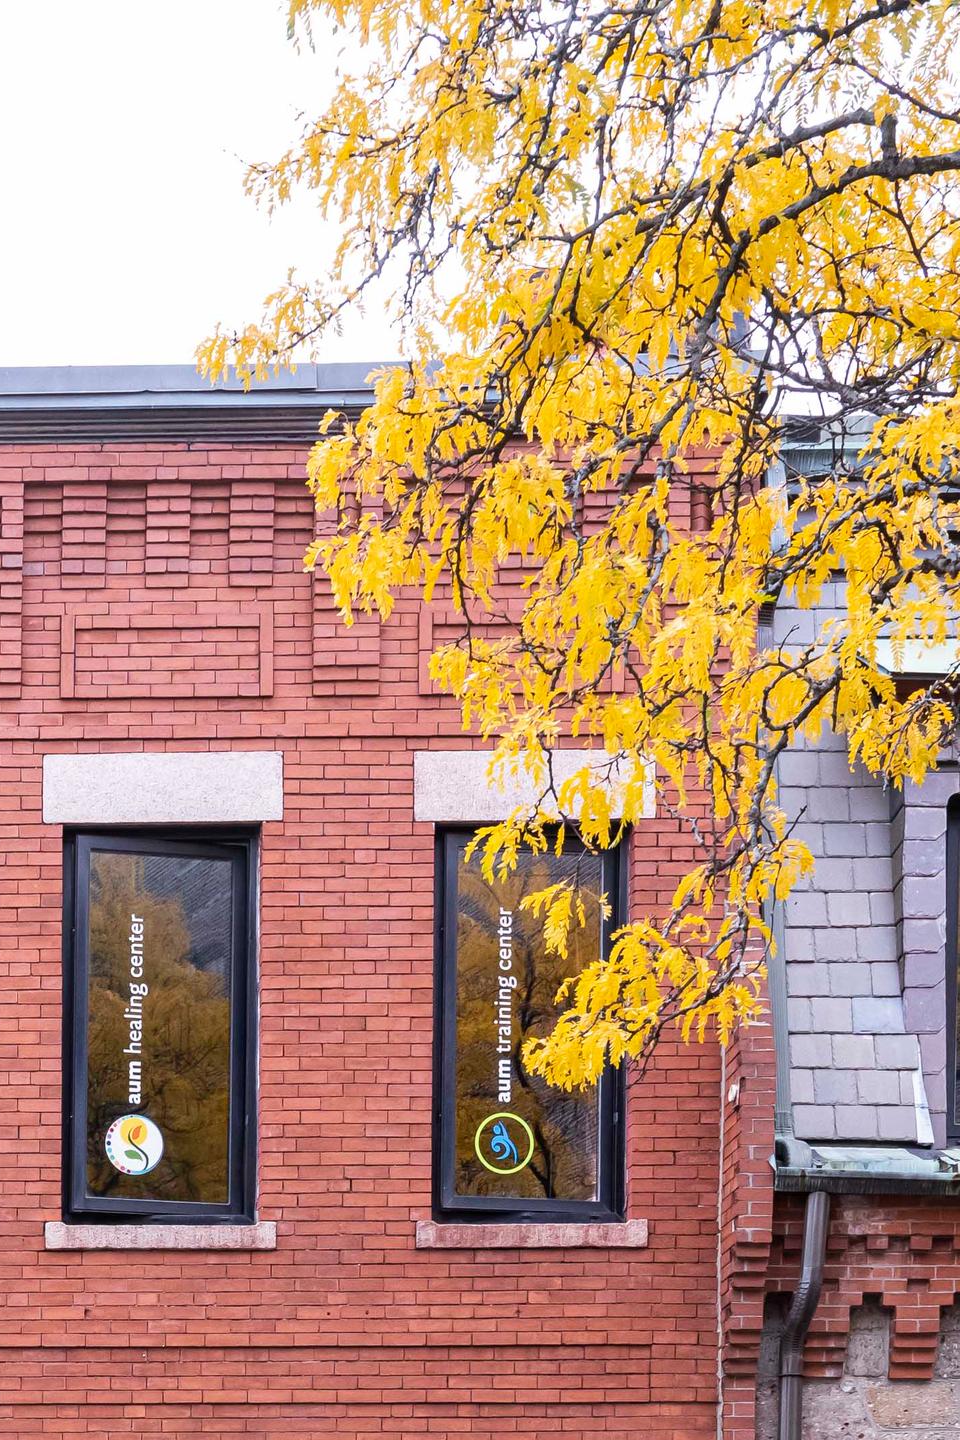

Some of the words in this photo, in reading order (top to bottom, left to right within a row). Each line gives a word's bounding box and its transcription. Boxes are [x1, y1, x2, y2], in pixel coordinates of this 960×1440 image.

[128, 913, 144, 978] center
[497, 907, 513, 971] center
[123, 982, 148, 1054] healing
[493, 975, 517, 1051] training
[128, 1061, 141, 1105] aum
[498, 1059, 511, 1103] aum
